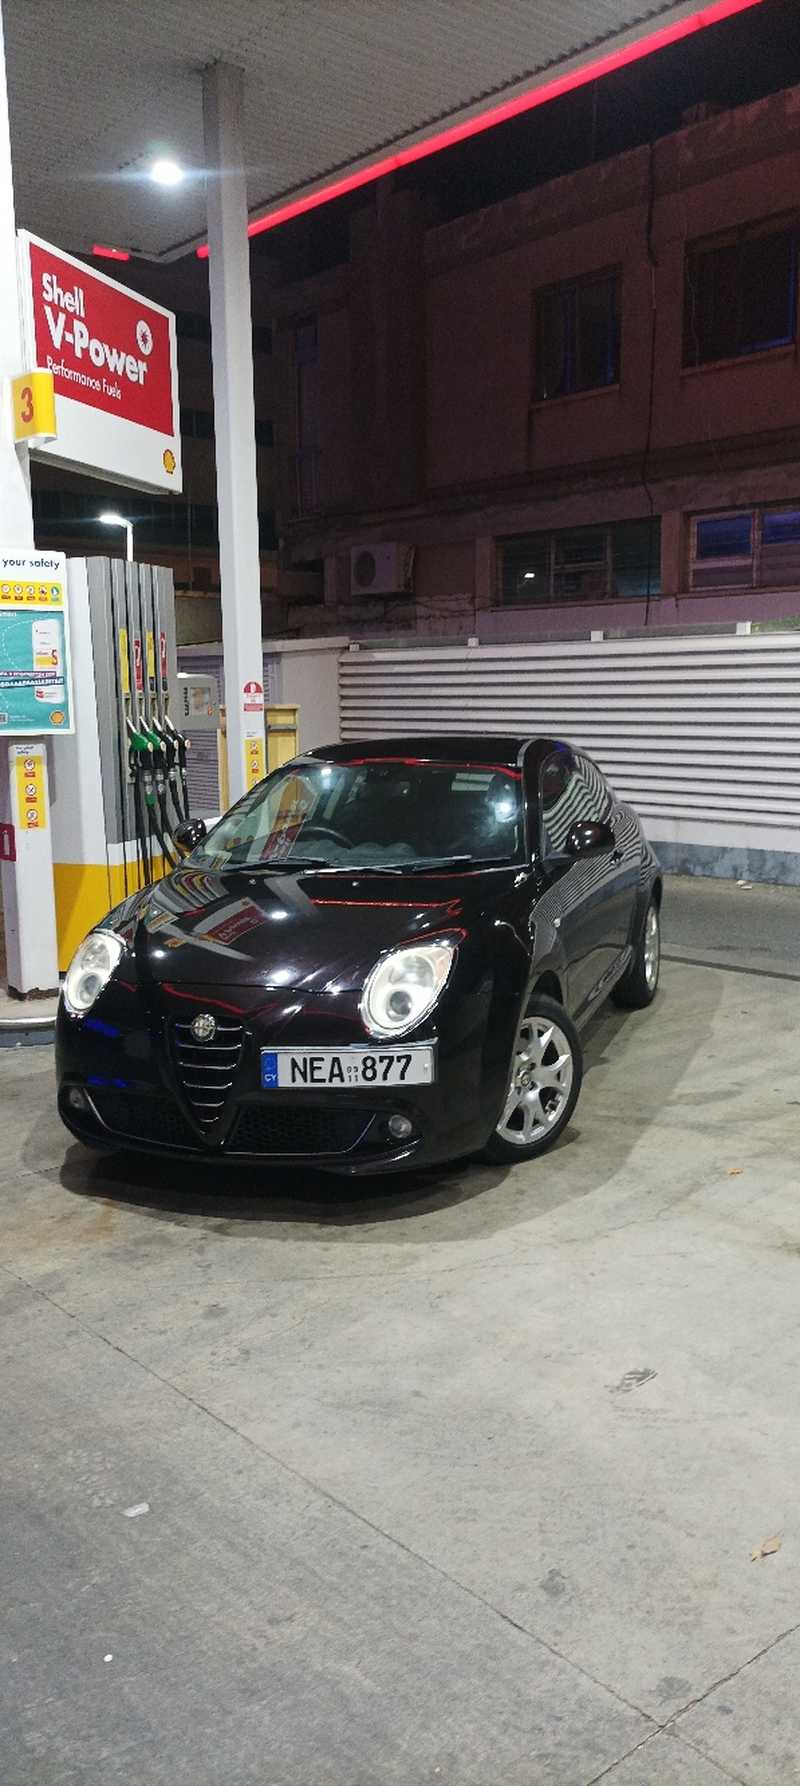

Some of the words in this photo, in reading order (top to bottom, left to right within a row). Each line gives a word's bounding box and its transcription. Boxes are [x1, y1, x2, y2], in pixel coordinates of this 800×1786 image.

[42, 272, 85, 318] Shell
[44, 305, 148, 386] V-Power
[46, 355, 101, 392] Performance
[102, 376, 122, 401] Fuels
[21, 387, 34, 423] 3
[2, 558, 26, 569] your
[29, 559, 60, 570] safety
[290, 1056, 345, 1084] NEA
[361, 1054, 412, 1082] 877
